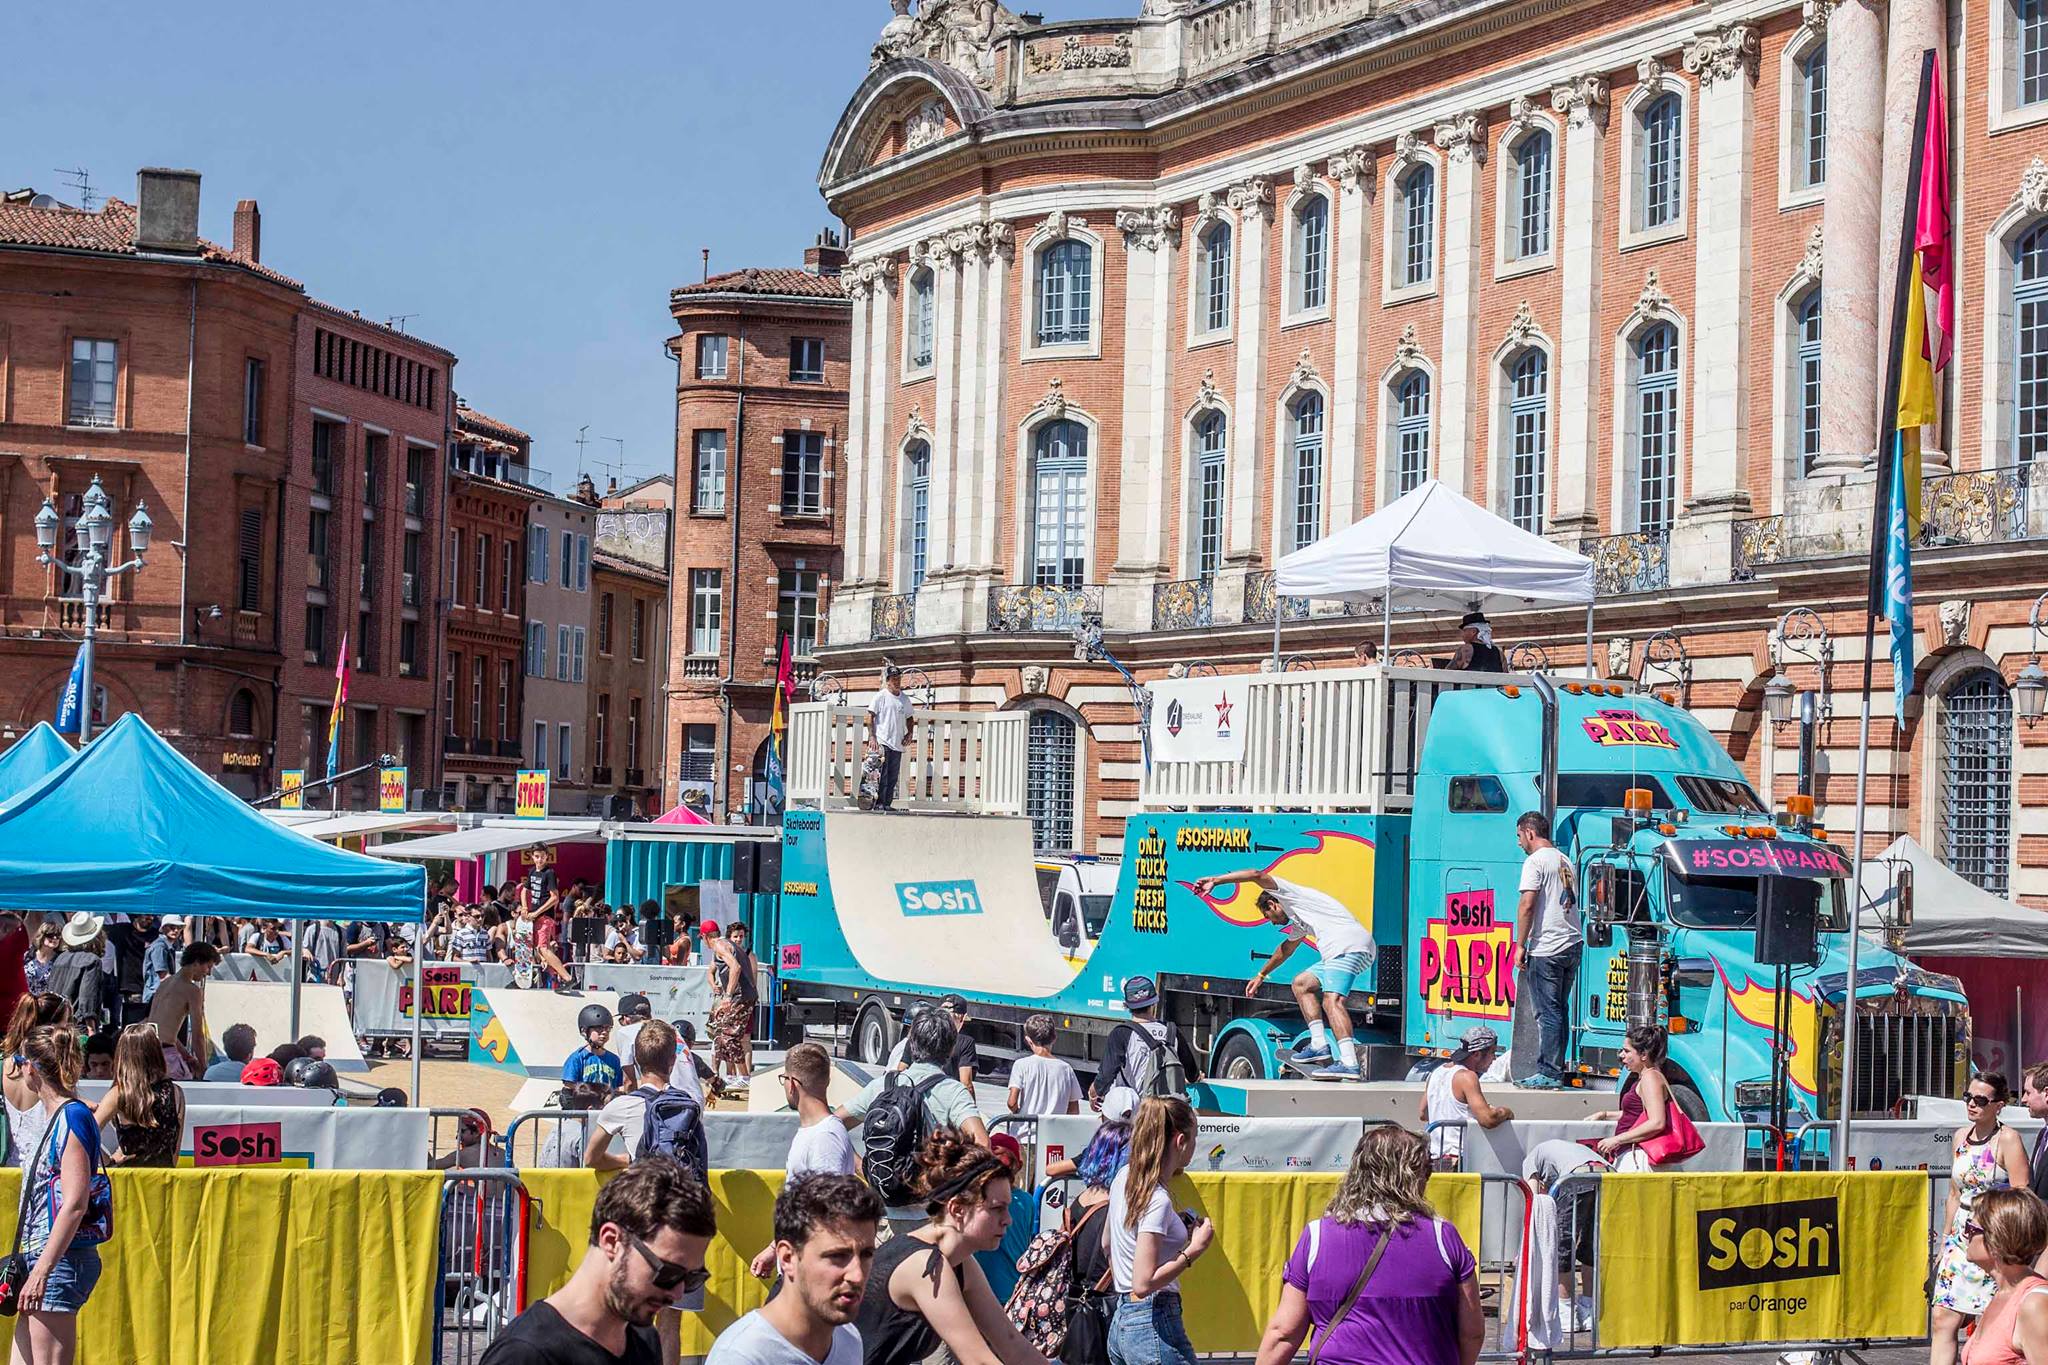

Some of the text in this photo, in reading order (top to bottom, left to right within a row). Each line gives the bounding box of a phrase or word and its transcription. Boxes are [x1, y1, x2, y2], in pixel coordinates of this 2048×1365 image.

[1602, 710, 1640, 720] Sosh
[1581, 722, 1680, 747] PARK
[223, 752, 261, 767] McDonald's
[516, 782, 546, 809] STORE
[786, 818, 820, 831] Skateboard
[786, 834, 799, 846] Tour
[1138, 838, 1166, 858] ONLY
[1176, 828, 1251, 853] #SOSHPARK
[1135, 858, 1168, 880] TRUCK
[1692, 848, 1847, 873] #SOSHPARK
[784, 882, 818, 897] #SOSHPARK
[903, 886, 977, 910] Sosh
[1134, 889, 1166, 910] FRESH
[1132, 909, 1168, 934] TRICKS
[1450, 898, 1492, 927] Sosh
[783, 949, 800, 965] Sosh
[1609, 957, 1628, 971] ONL
[425, 970, 458, 983] Sosh
[1420, 936, 1517, 1007] PARK
[1606, 971, 1629, 985] TRUC
[1606, 993, 1628, 1007] FRES
[200, 1130, 275, 1158] Sosh
[1934, 1133, 1952, 1142] Sosh
[1707, 1217, 1829, 1271] Sosh
[1729, 1294, 1807, 1314] par Orange
